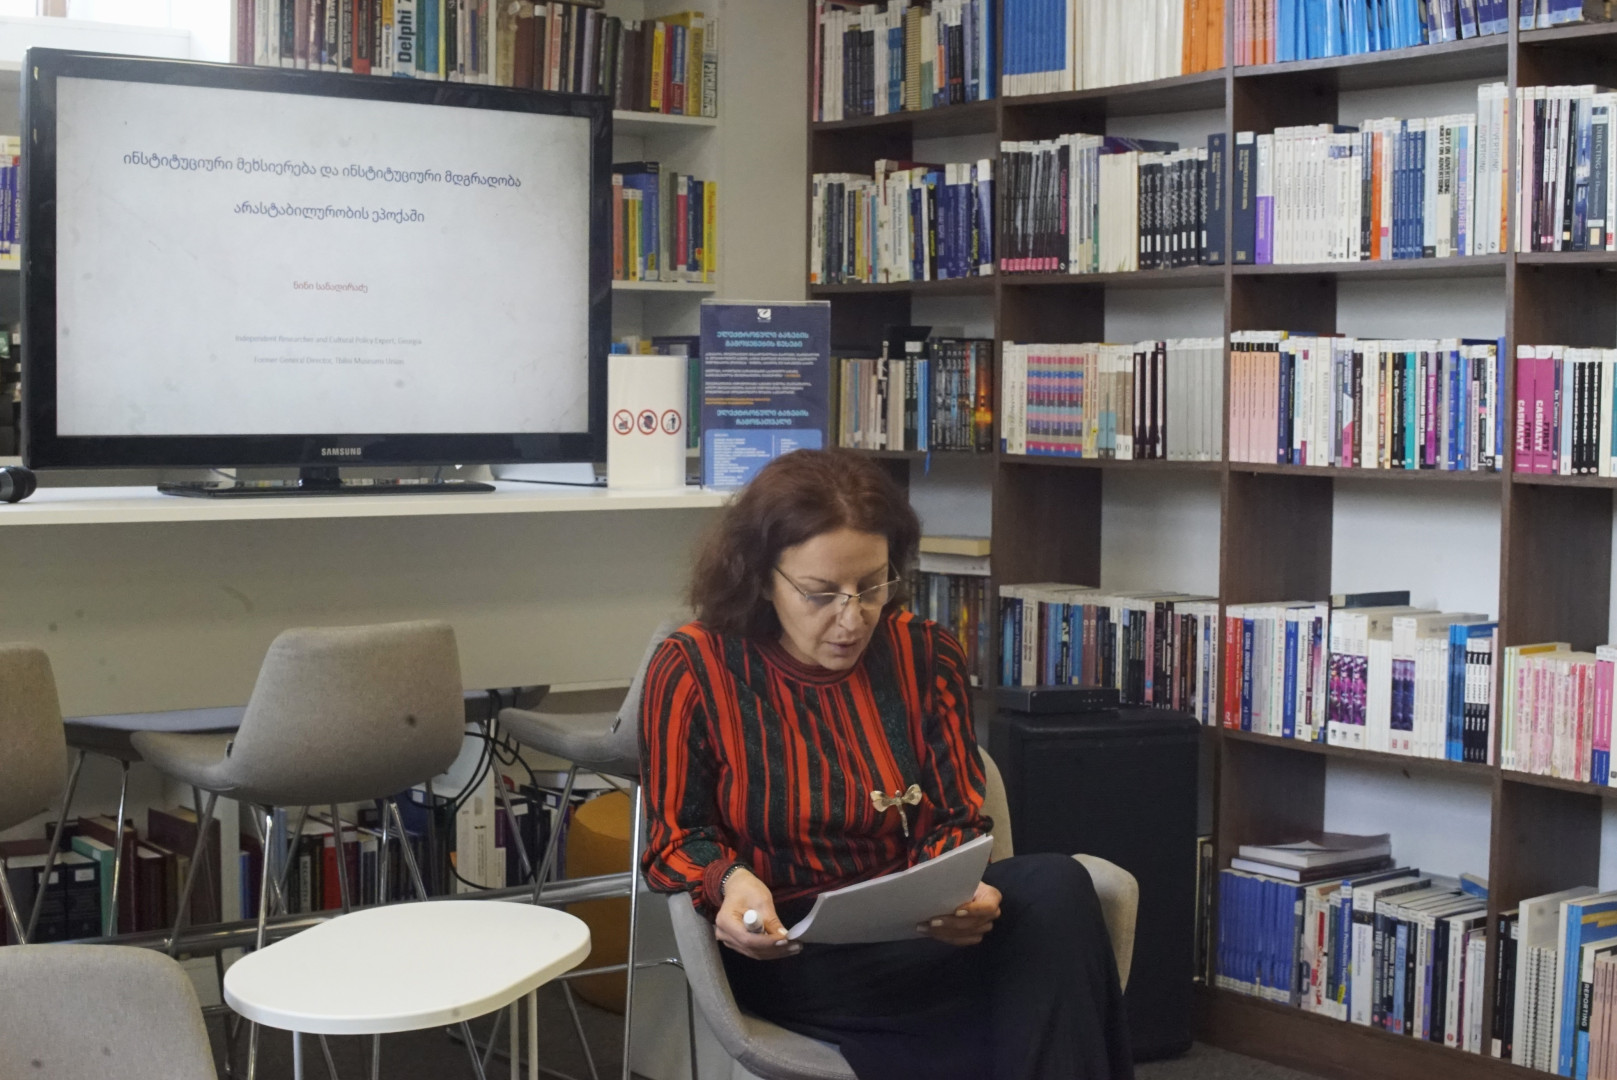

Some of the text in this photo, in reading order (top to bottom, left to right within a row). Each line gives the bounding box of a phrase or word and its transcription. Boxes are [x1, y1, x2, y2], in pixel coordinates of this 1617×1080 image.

[397, 10, 416, 63] Delphi
[1438, 146, 1444, 156] ON
[1445, 146, 1451, 154] ON
[1594, 126, 1603, 169] DIRECTING
[123, 150, 522, 189] ინსტიტუციური მეხსიერება და ინსტიტუციური მდგრადობა
[234, 200, 425, 225] არასტაბილურობის ეპოქაში
[1458, 181, 1467, 234] INDUSTRIES
[293, 281, 314, 291] ნინი
[235, 335, 422, 347] Independent Researcher and Cultural Policy Expert, Georgia
[254, 356, 278, 365] Former
[279, 357, 305, 366] General
[306, 357, 333, 366] Director,
[354, 358, 384, 366] Museums
[385, 359, 404, 367] Union
[1554, 390, 1559, 400] On
[1516, 400, 1525, 451] CASUALTY
[1534, 400, 1543, 452] CASUALTY
[1472, 434, 1477, 442] OF
[321, 447, 362, 456] SAMSUNG
[1374, 930, 1383, 950] VIDEO
[1581, 983, 1590, 1027] REPORTING
